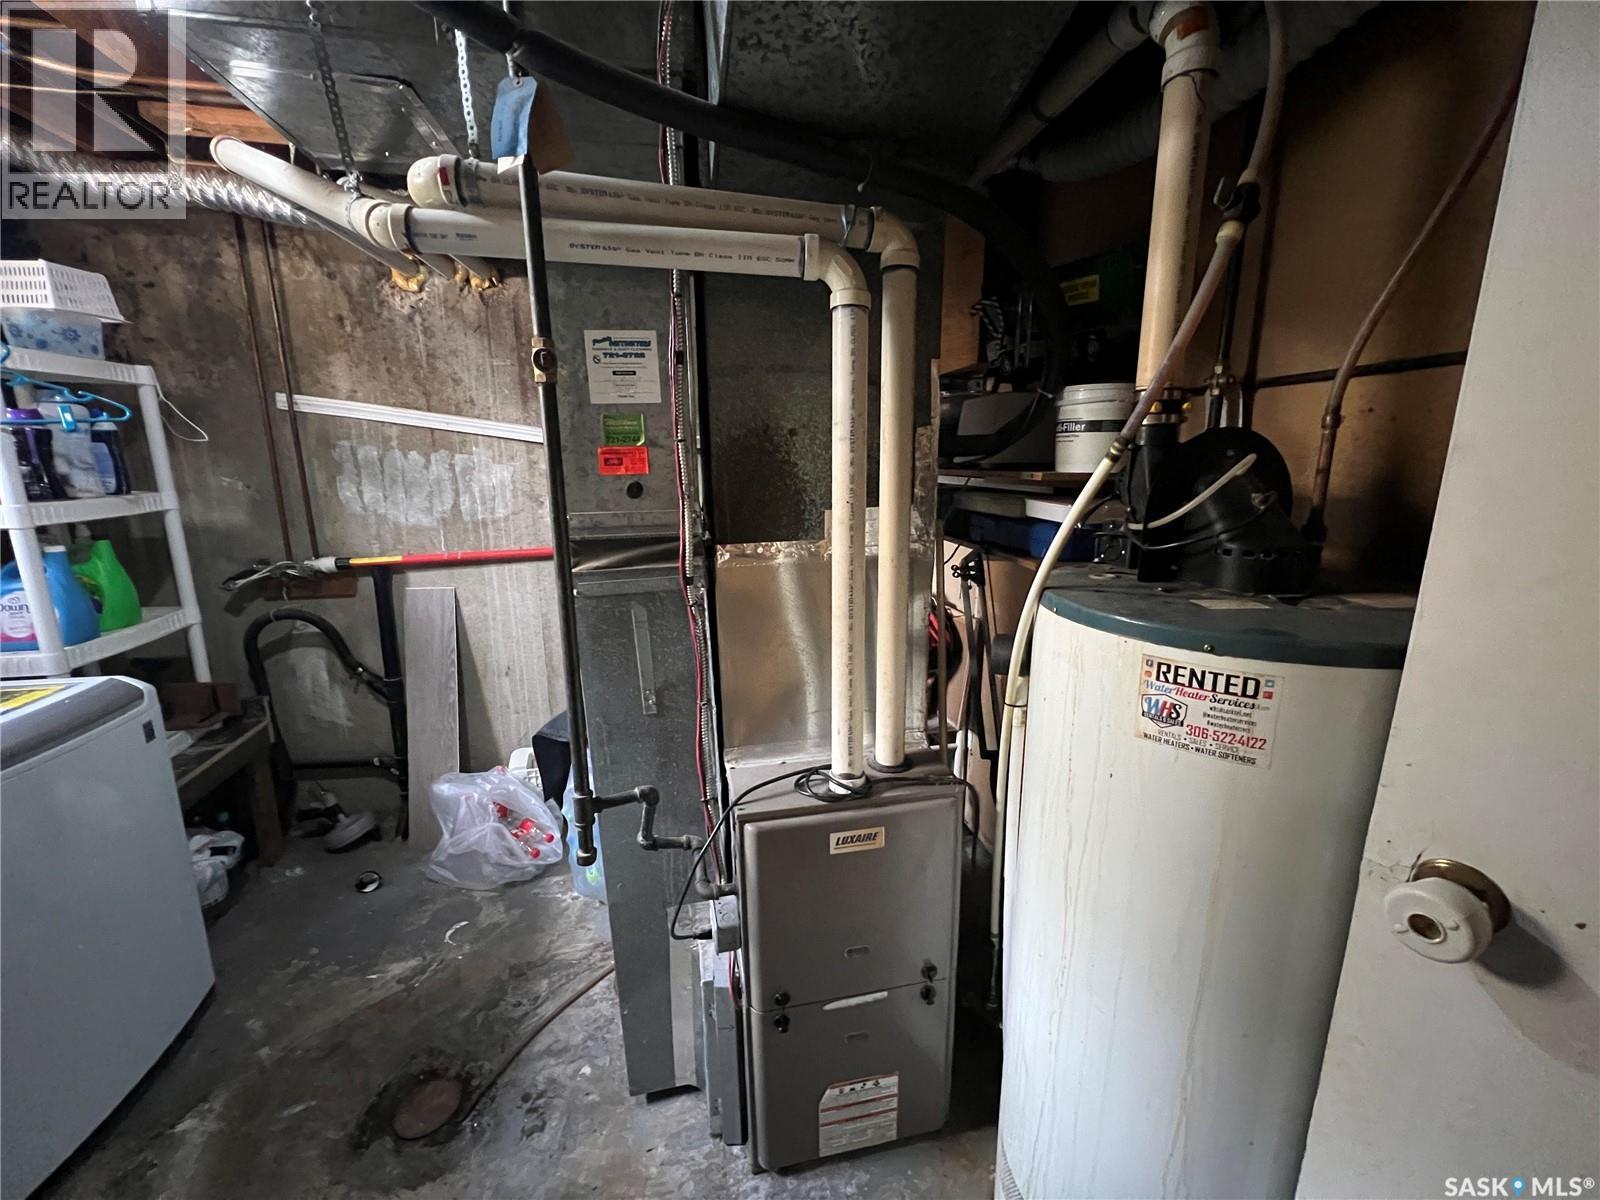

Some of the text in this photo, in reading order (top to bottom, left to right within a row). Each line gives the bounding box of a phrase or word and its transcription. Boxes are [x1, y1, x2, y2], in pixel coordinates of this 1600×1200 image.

[1143, 679, 1175, 694] Water
[1174, 687, 1210, 702] Heater
[1209, 694, 1257, 710] Services
[1155, 661, 1261, 700] RENTED
[1143, 732, 1257, 765] WATER HEATERS WATER SOFTENERS
[1157, 729, 1240, 754] RENTALS SALES SERVICE
[1185, 724, 1267, 750] 306-522-4122
[835, 832, 879, 846] LUXAIRE
